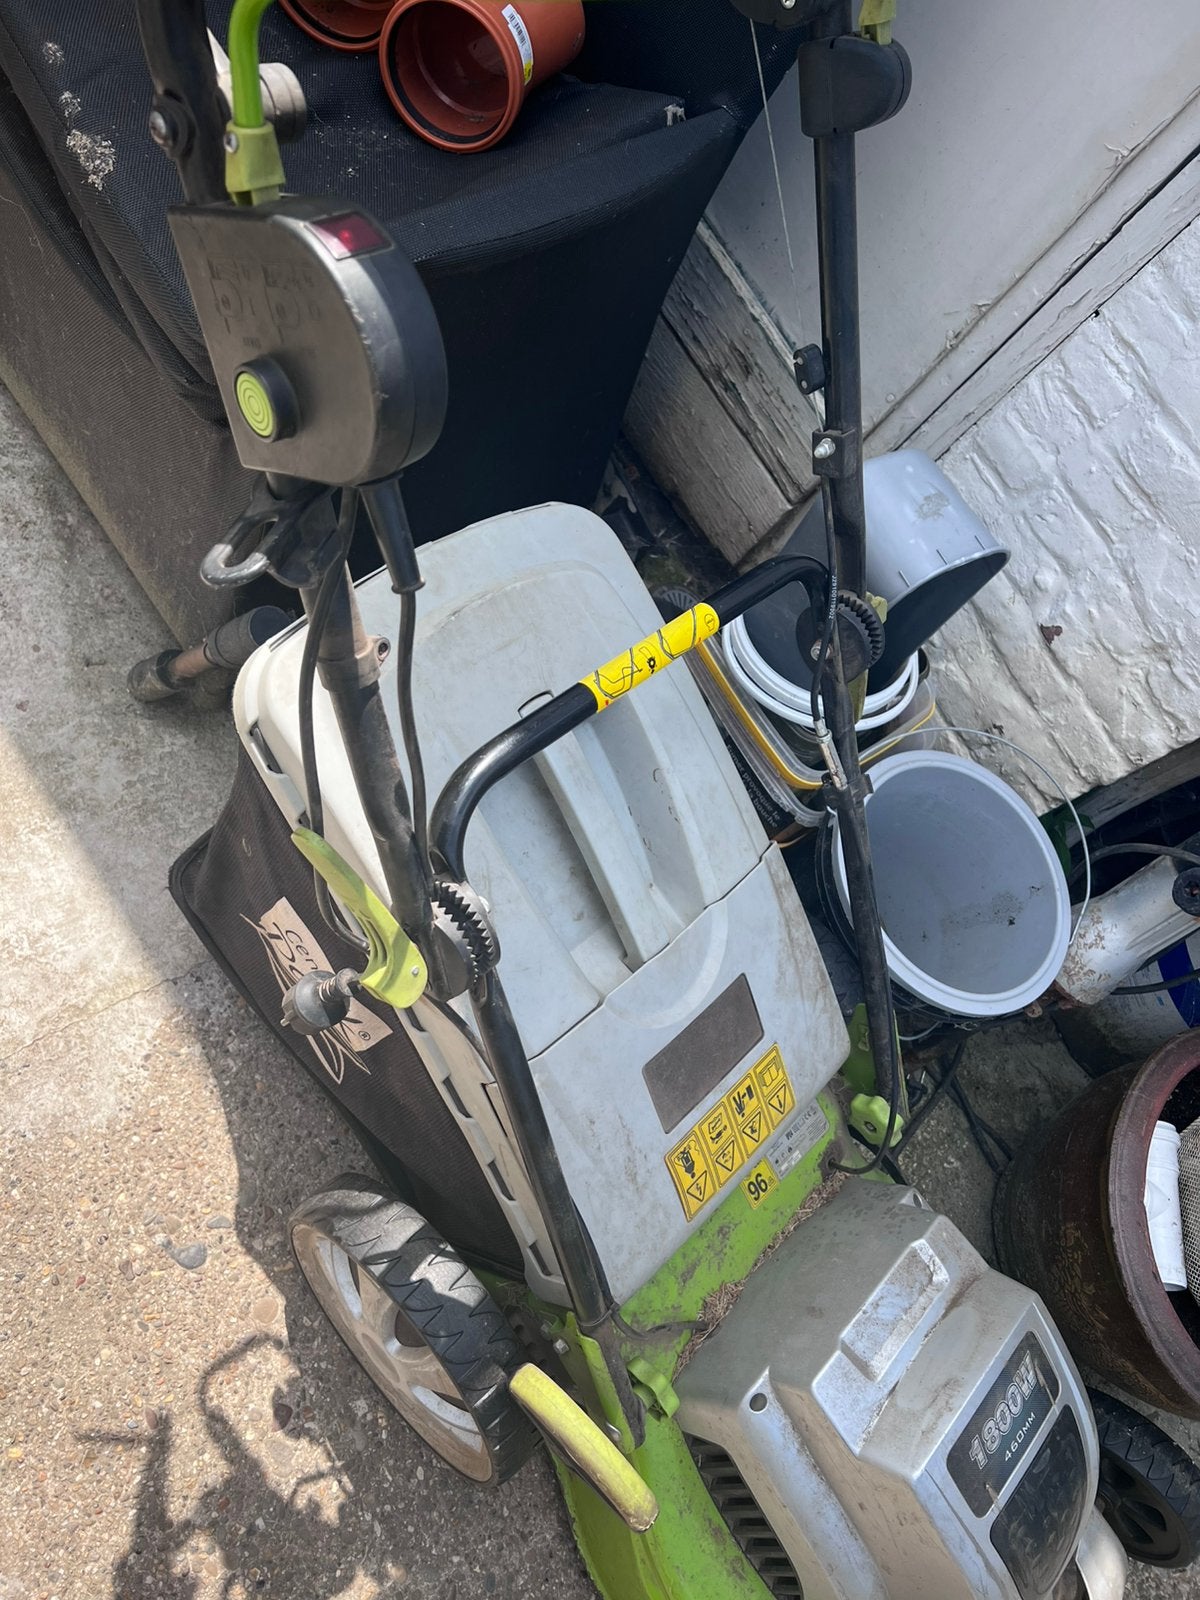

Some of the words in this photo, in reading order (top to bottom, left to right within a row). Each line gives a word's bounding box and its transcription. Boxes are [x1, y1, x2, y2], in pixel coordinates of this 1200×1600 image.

[743, 773, 773, 811] provoque
[772, 811, 780, 821] le
[754, 798, 777, 827] bouche
[747, 1172, 768, 1201] 96
[968, 1349, 1037, 1470] 1800W
[1005, 1412, 1036, 1462] 460MM
